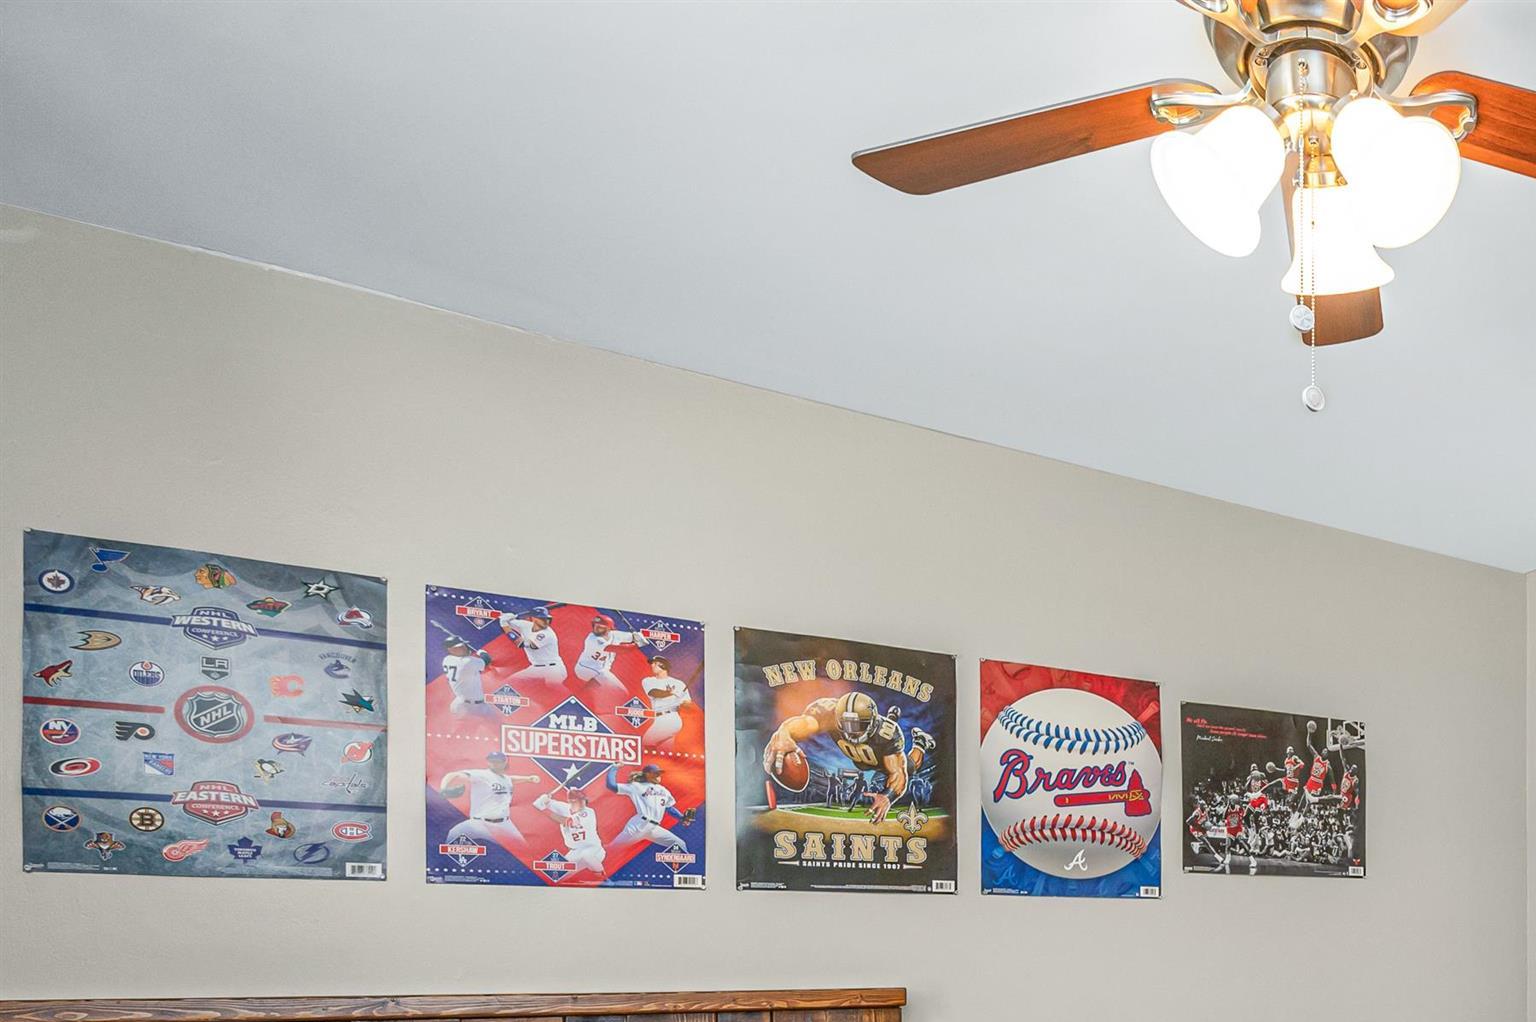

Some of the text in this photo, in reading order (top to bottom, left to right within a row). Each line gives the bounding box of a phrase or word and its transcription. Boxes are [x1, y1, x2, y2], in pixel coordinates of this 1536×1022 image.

[174, 615, 256, 635] WESTERN
[199, 610, 230, 619] NHL
[762, 658, 935, 703] NEW ORLEANS
[200, 705, 232, 727] NHL
[548, 713, 598, 732] MLB
[507, 729, 637, 761] SUPERSTARS
[993, 748, 1128, 803] Braves
[199, 784, 229, 792] NHL
[174, 791, 257, 808] EASTERN
[571, 831, 586, 842] 27
[773, 829, 928, 864] SAINTS
[1063, 848, 1088, 871] A
